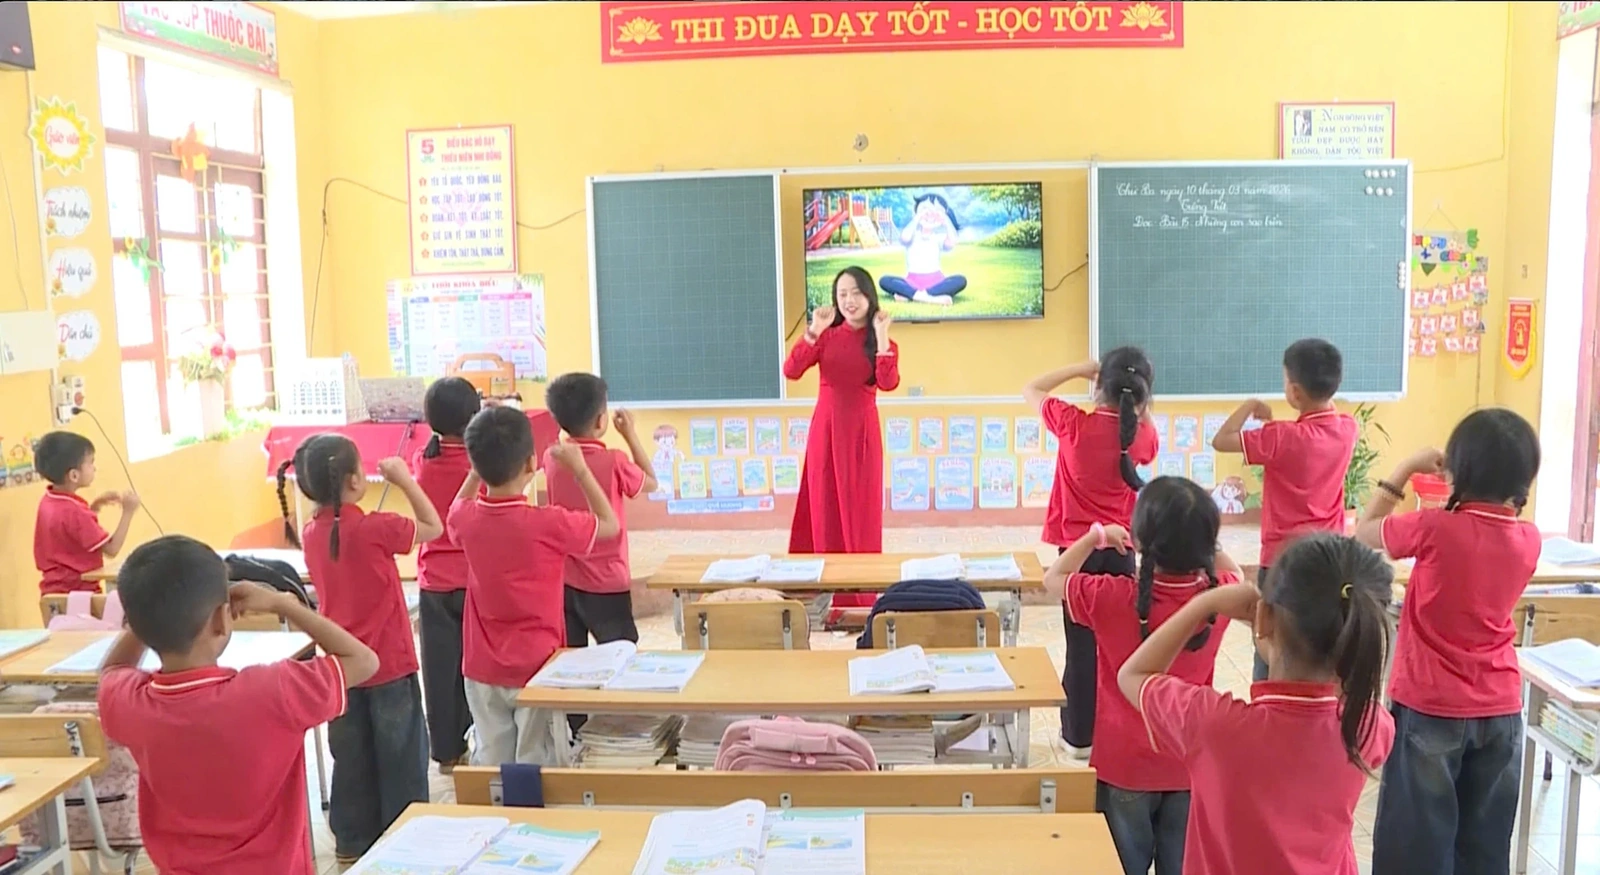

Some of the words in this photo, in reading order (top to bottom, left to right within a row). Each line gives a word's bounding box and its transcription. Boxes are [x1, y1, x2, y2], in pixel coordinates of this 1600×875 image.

[203, 7, 244, 49] THUỘC
[246, 19, 267, 53] BÀI
[671, 17, 725, 43] THI
[735, 14, 802, 41] ĐUA
[810, 11, 879, 44] DẠY
[887, 1, 949, 37] TỐT
[975, 7, 1042, 39] HỌC
[421, 138, 435, 155] 5
[1187, 184, 1197, 195] 10
[1228, 184, 1240, 195] 03
